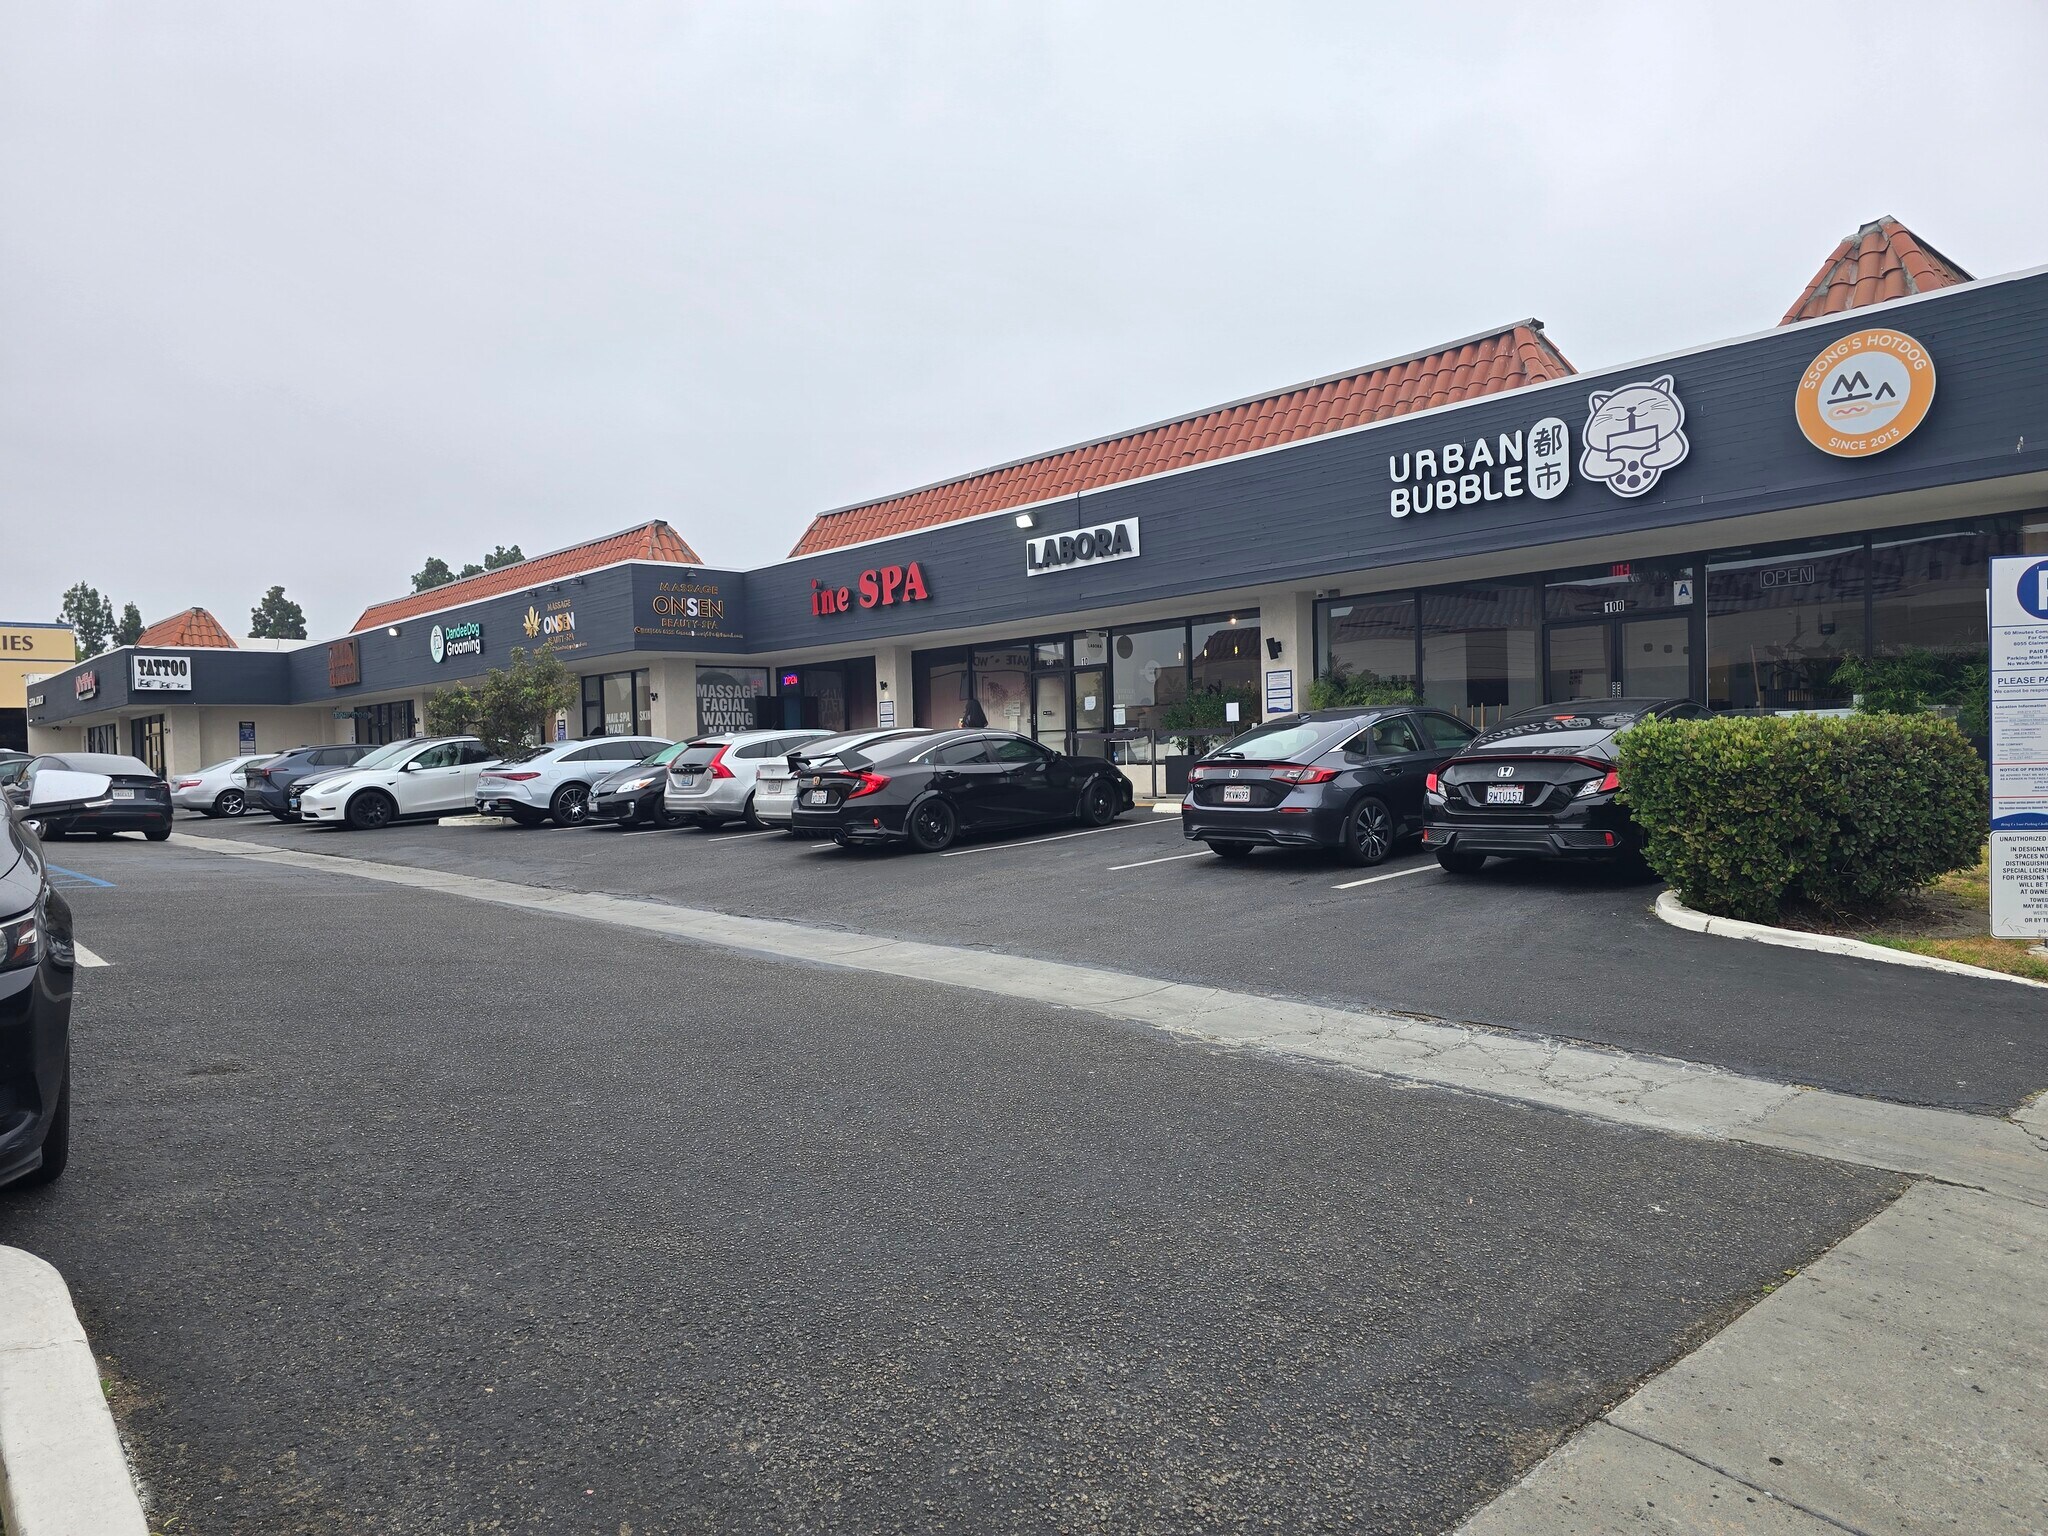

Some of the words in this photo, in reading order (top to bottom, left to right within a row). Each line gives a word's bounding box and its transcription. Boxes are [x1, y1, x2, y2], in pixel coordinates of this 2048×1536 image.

[1804, 337, 1862, 390] SSONG'S
[1866, 334, 1927, 371] HOTDOG
[1828, 437, 1867, 450] SINCE
[1870, 427, 1900, 448] 2013
[1389, 429, 1523, 483] URBAN
[1533, 424, 1563, 491] 都市
[1390, 465, 1525, 518] BUBBLE
[1027, 523, 1132, 570] LABORA
[1762, 566, 1812, 586] OPEN
[659, 582, 719, 595] MASSAGE
[810, 578, 849, 616] ine
[858, 560, 928, 609] SPA
[1678, 583, 1690, 596] A
[653, 595, 724, 620] ONSEN
[1605, 600, 1624, 612] 100
[445, 622, 480, 640] DandeeDog
[543, 611, 576, 635] ONSEN
[0, 635, 34, 651] IES
[446, 637, 481, 655] Grooming
[137, 659, 188, 677] TATTOO
[1998, 676, 2036, 685] PLEASE
[696, 683, 758, 698] MASSAGE
[703, 698, 749, 712] FACIAL
[702, 711, 754, 726] WAXING
